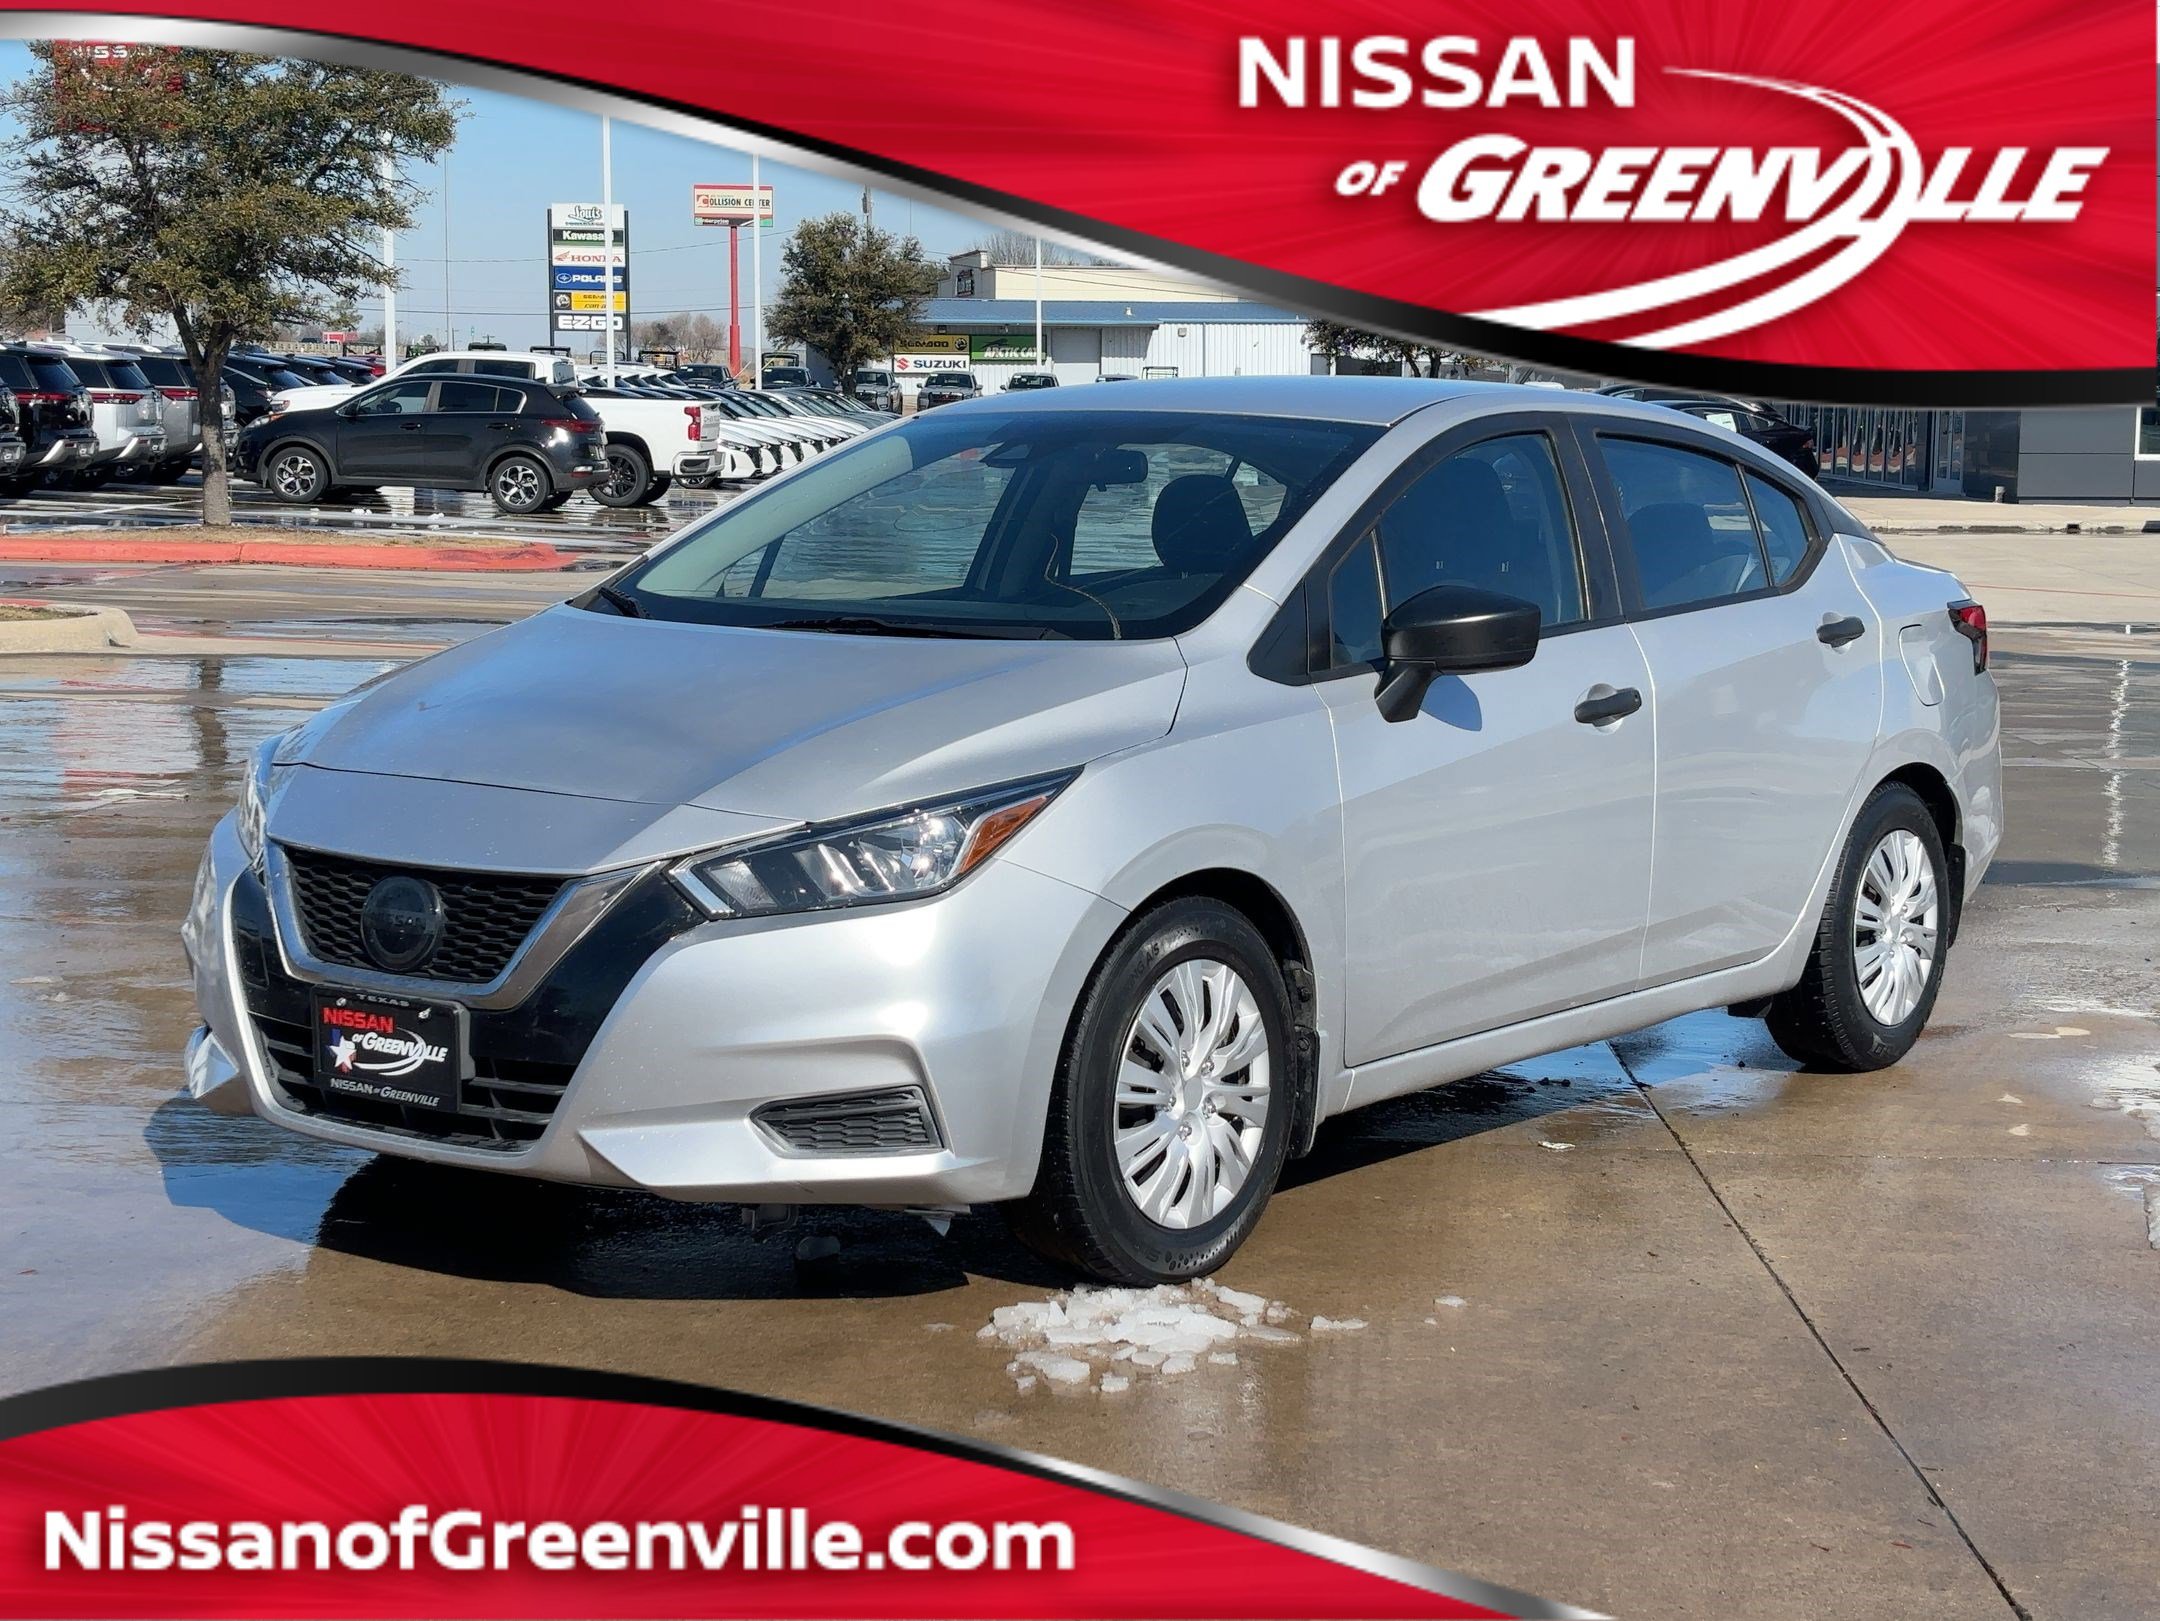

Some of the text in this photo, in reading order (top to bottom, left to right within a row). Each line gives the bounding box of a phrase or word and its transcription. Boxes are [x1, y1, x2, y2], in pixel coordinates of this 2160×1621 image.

[744, 198, 771, 207] CETER
[562, 230, 614, 241] Kawasai
[570, 255, 622, 263] HONA
[572, 274, 623, 284] POLAS
[913, 359, 967, 369] SUZUKI
[356, 993, 410, 1007] TEXAS
[322, 1007, 394, 1034] NISSAN
[351, 1031, 449, 1063] OF GREENVILLE
[330, 1077, 374, 1095] NISSAN
[380, 1086, 440, 1107] GREENVILLE
